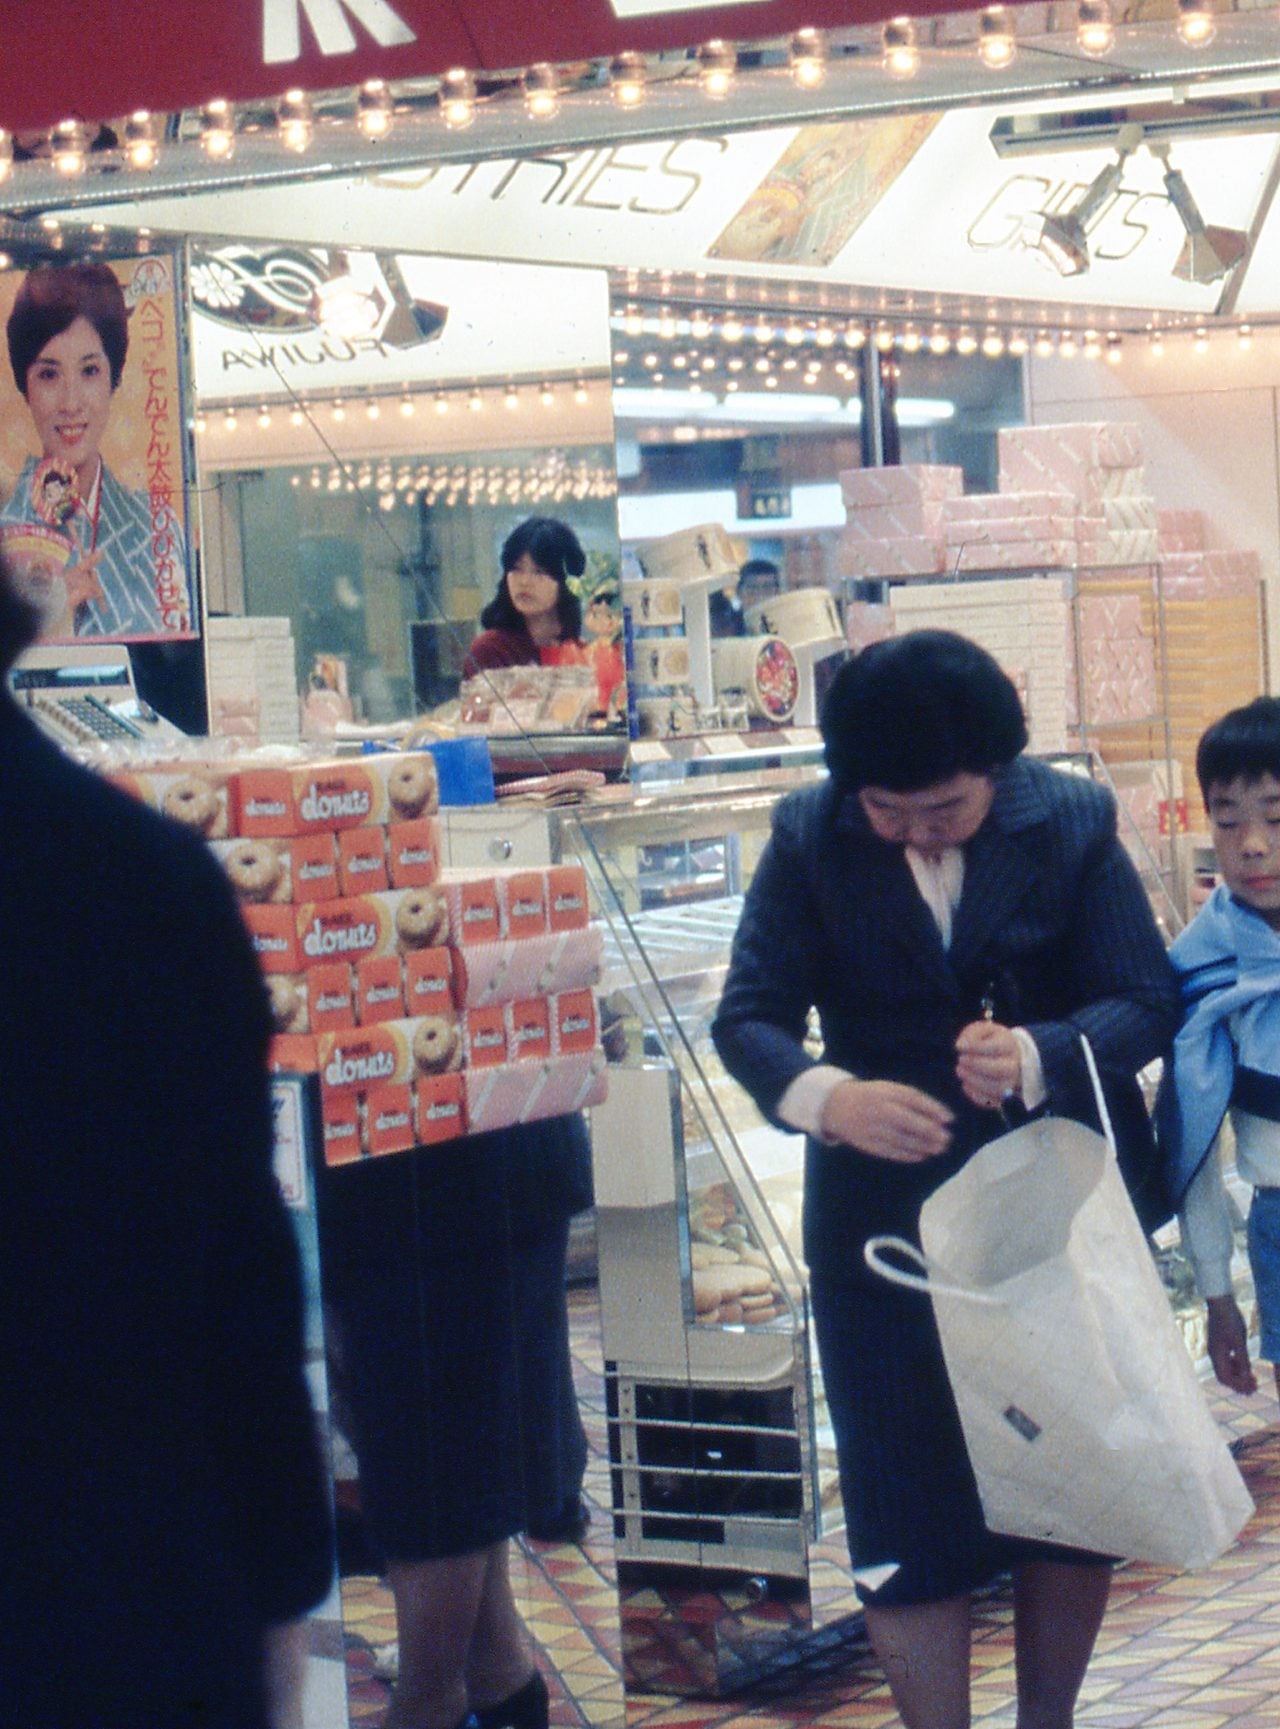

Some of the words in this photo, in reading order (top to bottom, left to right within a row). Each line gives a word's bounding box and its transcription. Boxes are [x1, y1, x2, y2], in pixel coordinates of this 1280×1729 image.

[300, 782, 369, 822] donuts
[303, 918, 376, 957] donuts
[325, 1048, 394, 1086] donuts
